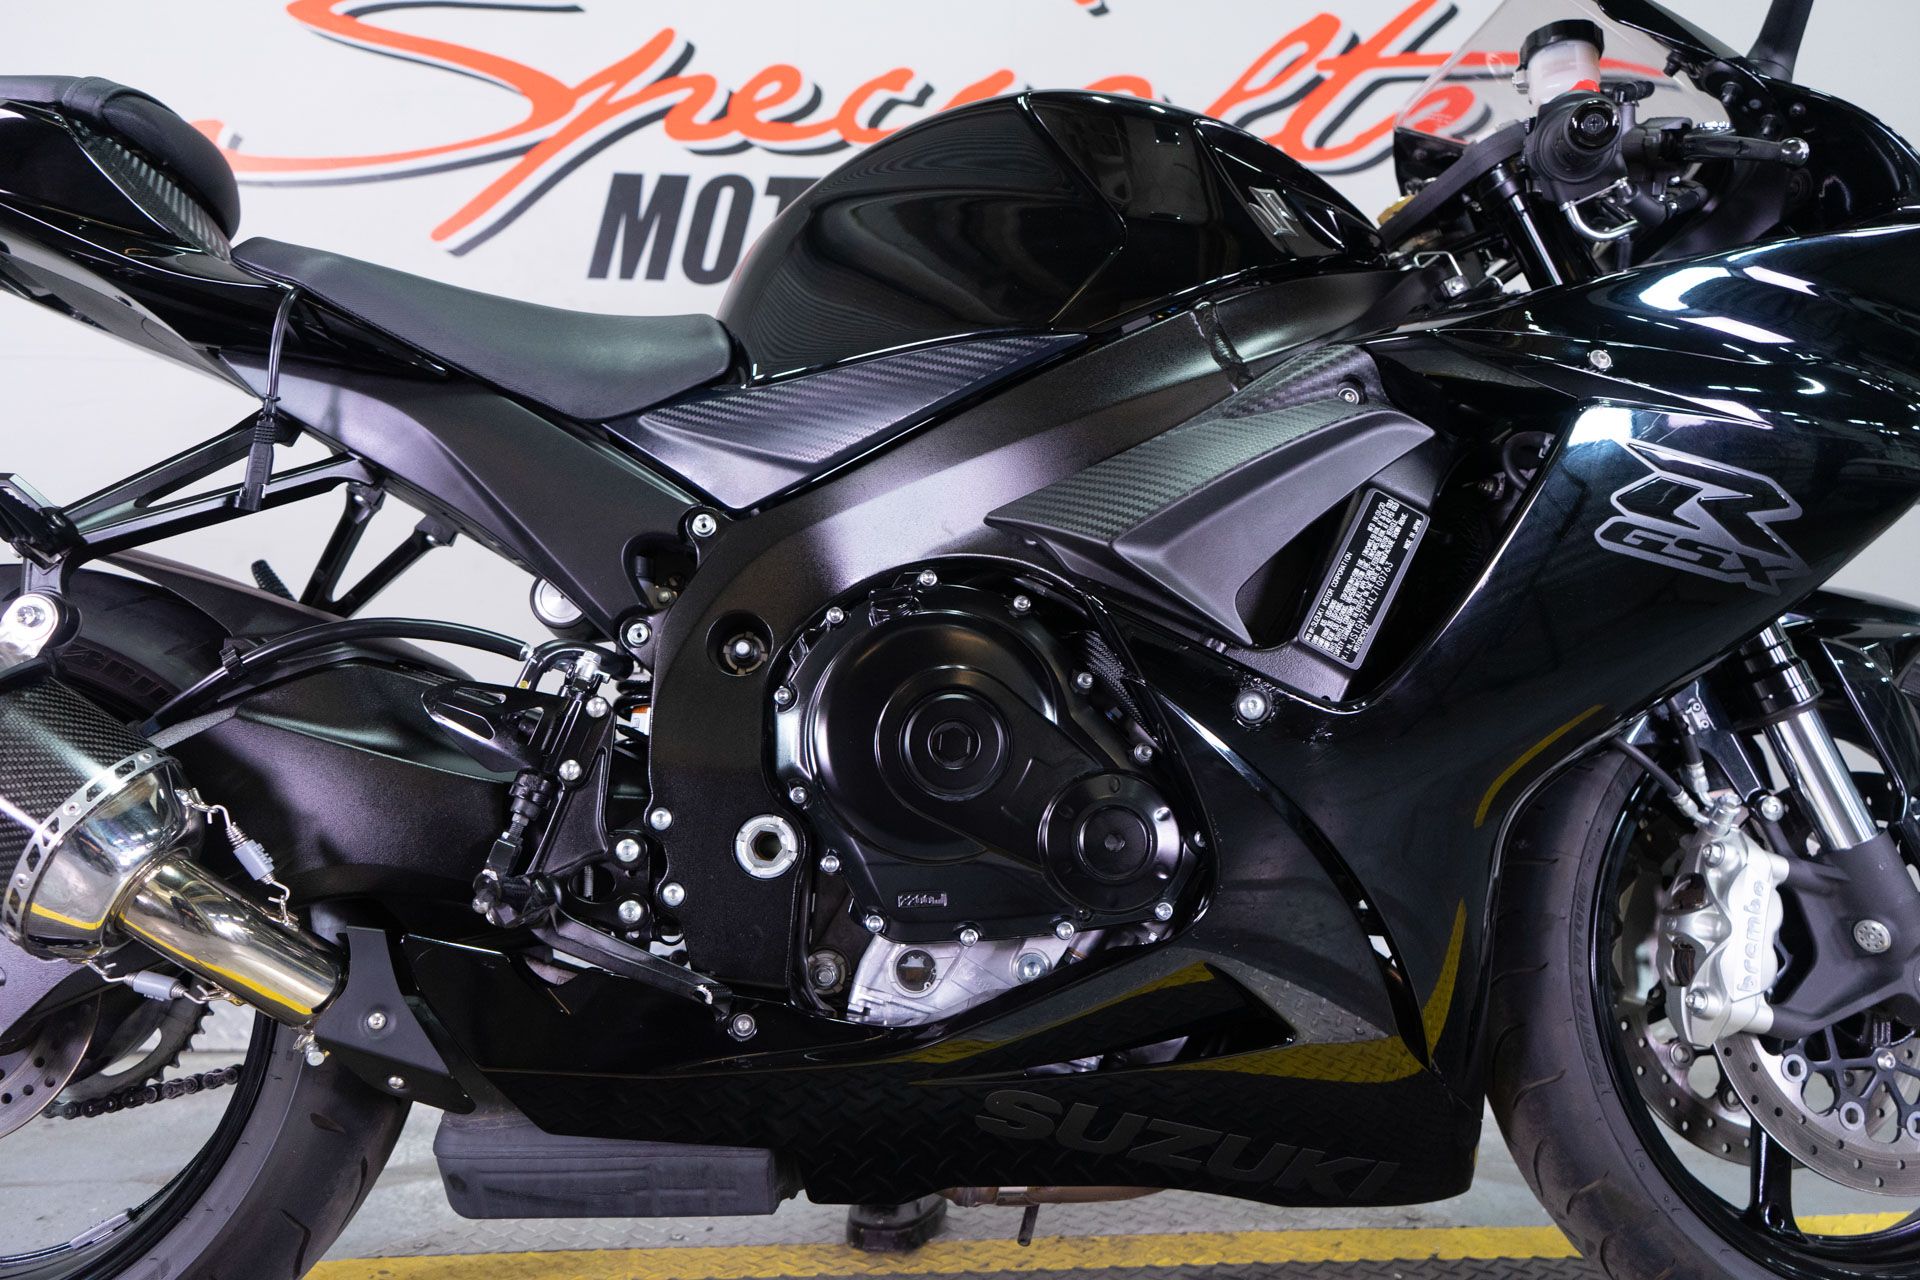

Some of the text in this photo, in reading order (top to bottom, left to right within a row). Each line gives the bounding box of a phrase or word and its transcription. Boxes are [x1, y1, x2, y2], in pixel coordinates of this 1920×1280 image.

[1321, 588, 1335, 607] MOTOR
[1330, 551, 1353, 588] CORPORATION
[1736, 879, 1767, 993] brembo
[975, 1089, 1400, 1199] SUZUKI
